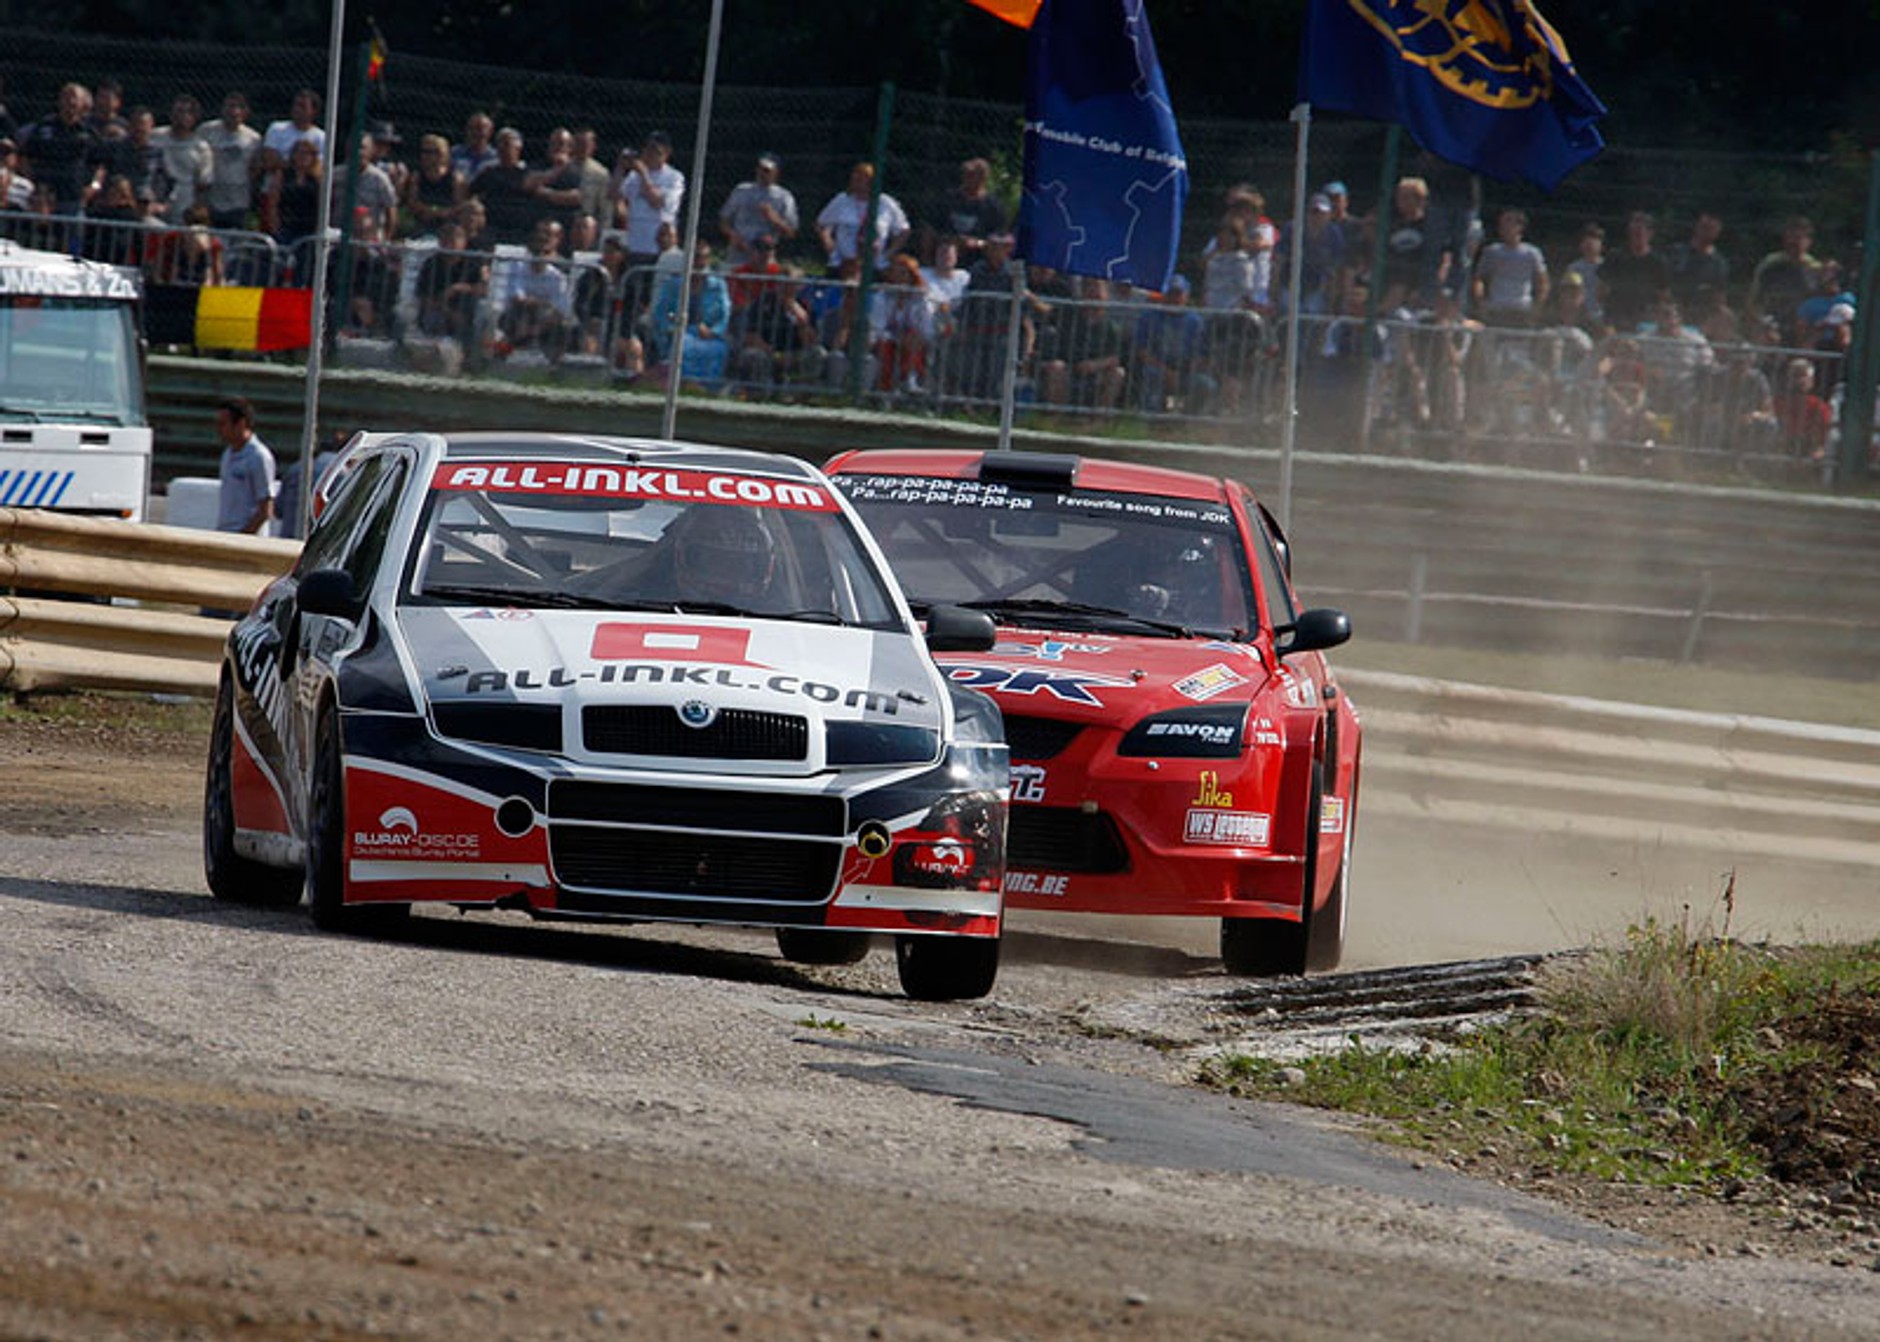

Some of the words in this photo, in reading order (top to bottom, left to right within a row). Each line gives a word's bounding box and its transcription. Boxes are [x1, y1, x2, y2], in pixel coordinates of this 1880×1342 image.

[1088, 137, 1122, 153] Club
[1125, 146, 1142, 157] of
[1057, 495, 1123, 510] Favourite
[1126, 502, 1162, 516] song
[1164, 506, 1197, 519] from
[1200, 511, 1231, 525] JDK
[934, 662, 1106, 709] DK
[1166, 723, 1235, 738] AVON
[1192, 771, 1233, 807] Sika
